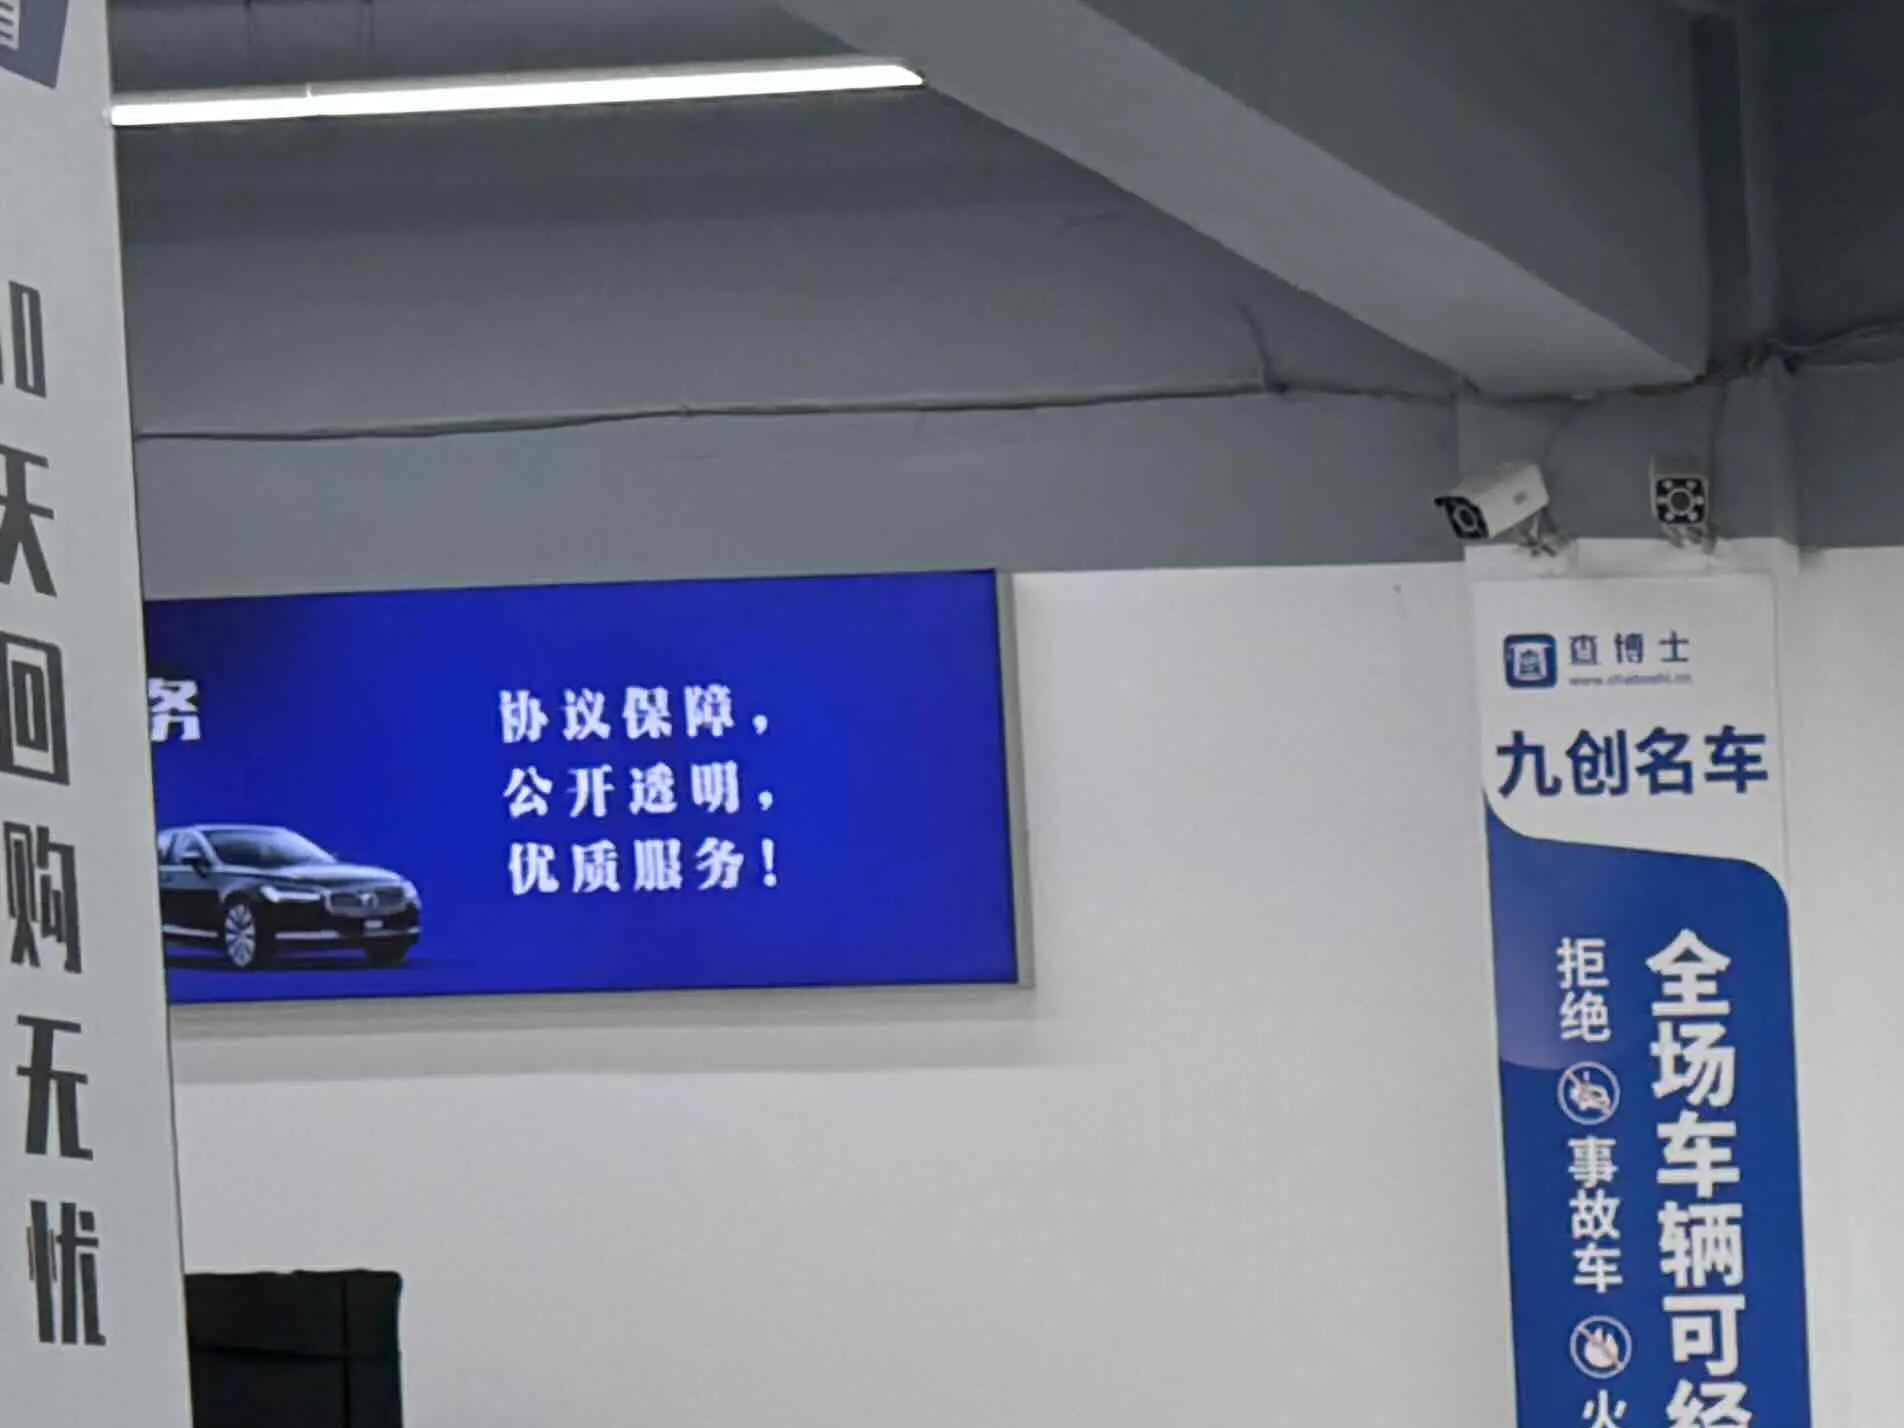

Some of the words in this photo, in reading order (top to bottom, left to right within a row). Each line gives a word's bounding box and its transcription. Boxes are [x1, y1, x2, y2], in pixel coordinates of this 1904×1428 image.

[1568, 630, 1691, 666] 查博士
[0, 281, 106, 1346] 0天回购无忧
[1496, 725, 1770, 799] 九创名车
[1556, 937, 1611, 1043] 拒绝
[1567, 1135, 1624, 1294] 事故车
